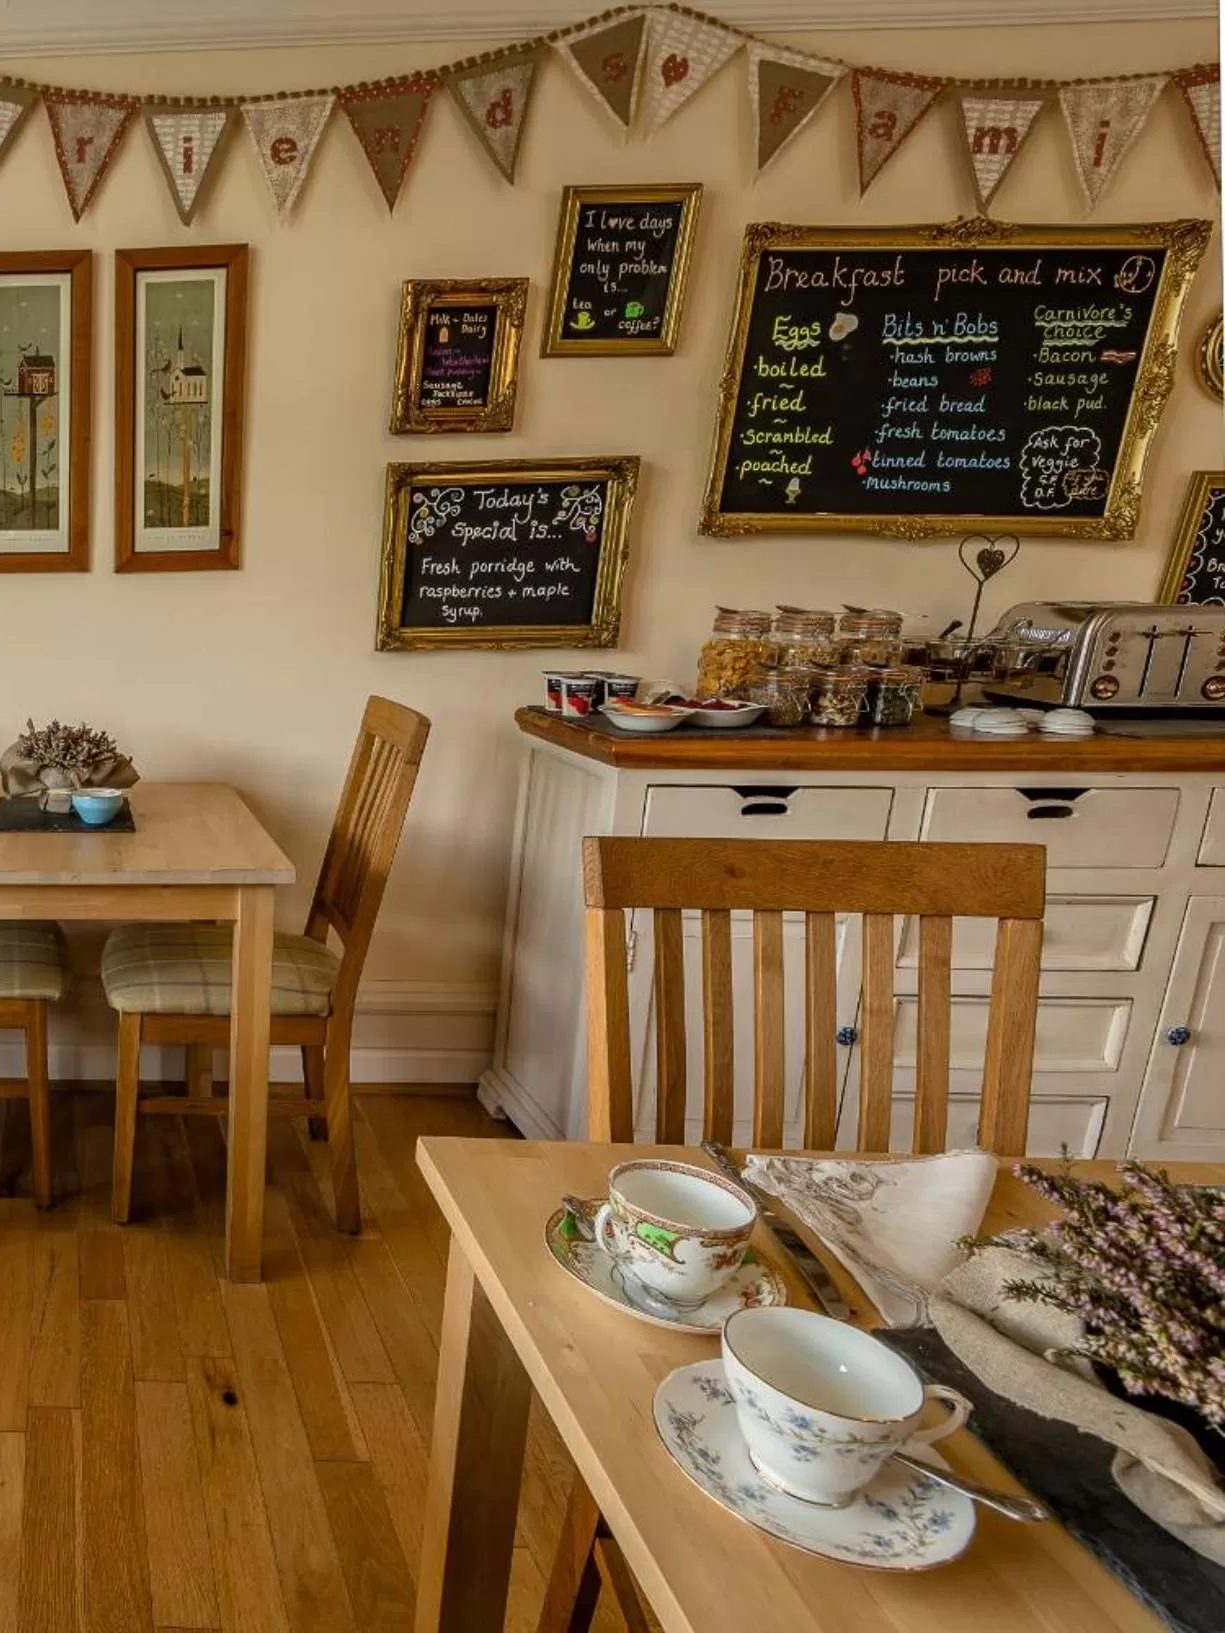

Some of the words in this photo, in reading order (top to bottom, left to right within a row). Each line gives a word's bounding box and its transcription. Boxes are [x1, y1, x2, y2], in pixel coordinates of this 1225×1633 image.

[583, 209, 596, 228] I
[639, 211, 673, 239] days
[625, 240, 646, 261] my
[579, 259, 609, 281] only
[619, 259, 668, 280] problem
[764, 255, 905, 306] Breakfast
[933, 258, 988, 302] pick
[998, 259, 1042, 286] and
[1054, 265, 1102, 286] mix
[572, 297, 592, 310] tea
[604, 308, 617, 316] or
[618, 316, 660, 335] coffee?
[881, 311, 924, 338] Bits
[953, 312, 999, 337] Bobs
[461, 323, 487, 339] Dairy
[771, 314, 822, 347] Eggs
[757, 355, 826, 378] boiled
[894, 346, 935, 364] hash
[945, 347, 997, 364] browns
[1037, 349, 1096, 364] Bacon
[891, 370, 939, 388] beans
[747, 390, 807, 418] fried
[881, 395, 929, 417] fried
[939, 393, 987, 413] bread
[1027, 396, 1069, 411] black
[1074, 395, 1108, 418] pud.
[876, 422, 925, 443] fresh
[930, 424, 1007, 442] tomatoes
[1032, 434, 1059, 449] Ask
[1060, 436, 1090, 457] for
[739, 454, 813, 480] poached
[871, 450, 926, 468] tinned
[936, 451, 1011, 469] tomatoes
[473, 488, 550, 524] Today's
[451, 518, 518, 547] Special
[421, 555, 461, 575] Fresh
[469, 556, 536, 582] porridge
[545, 556, 581, 572] with
[419, 585, 502, 602] raspberries
[522, 583, 570, 601] maple
